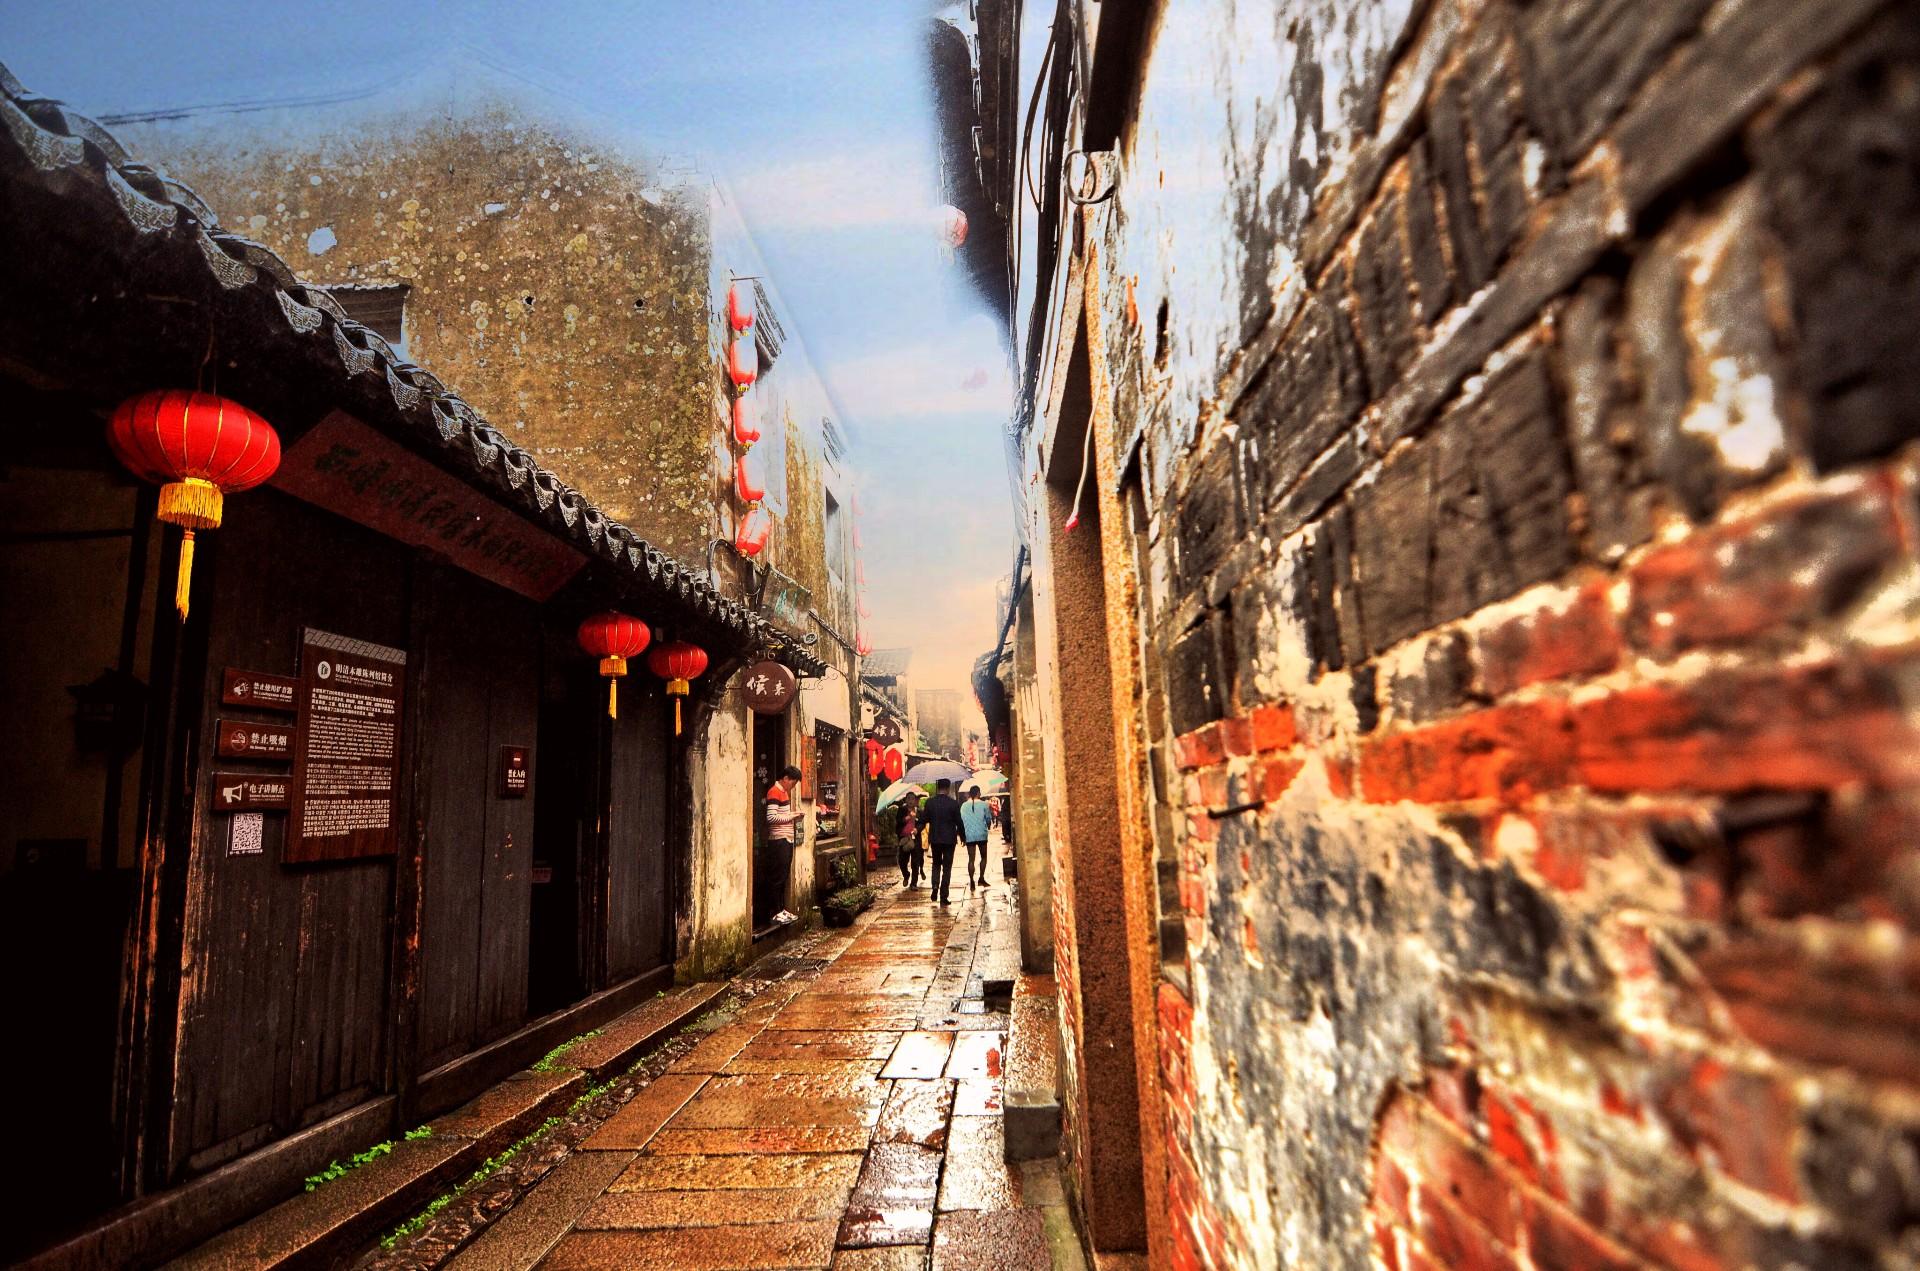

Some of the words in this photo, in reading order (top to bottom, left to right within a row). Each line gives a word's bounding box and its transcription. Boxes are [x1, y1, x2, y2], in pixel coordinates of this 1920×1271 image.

[251, 732, 287, 746] 禁止吸烟
[249, 783, 285, 794] 电子讲解点
